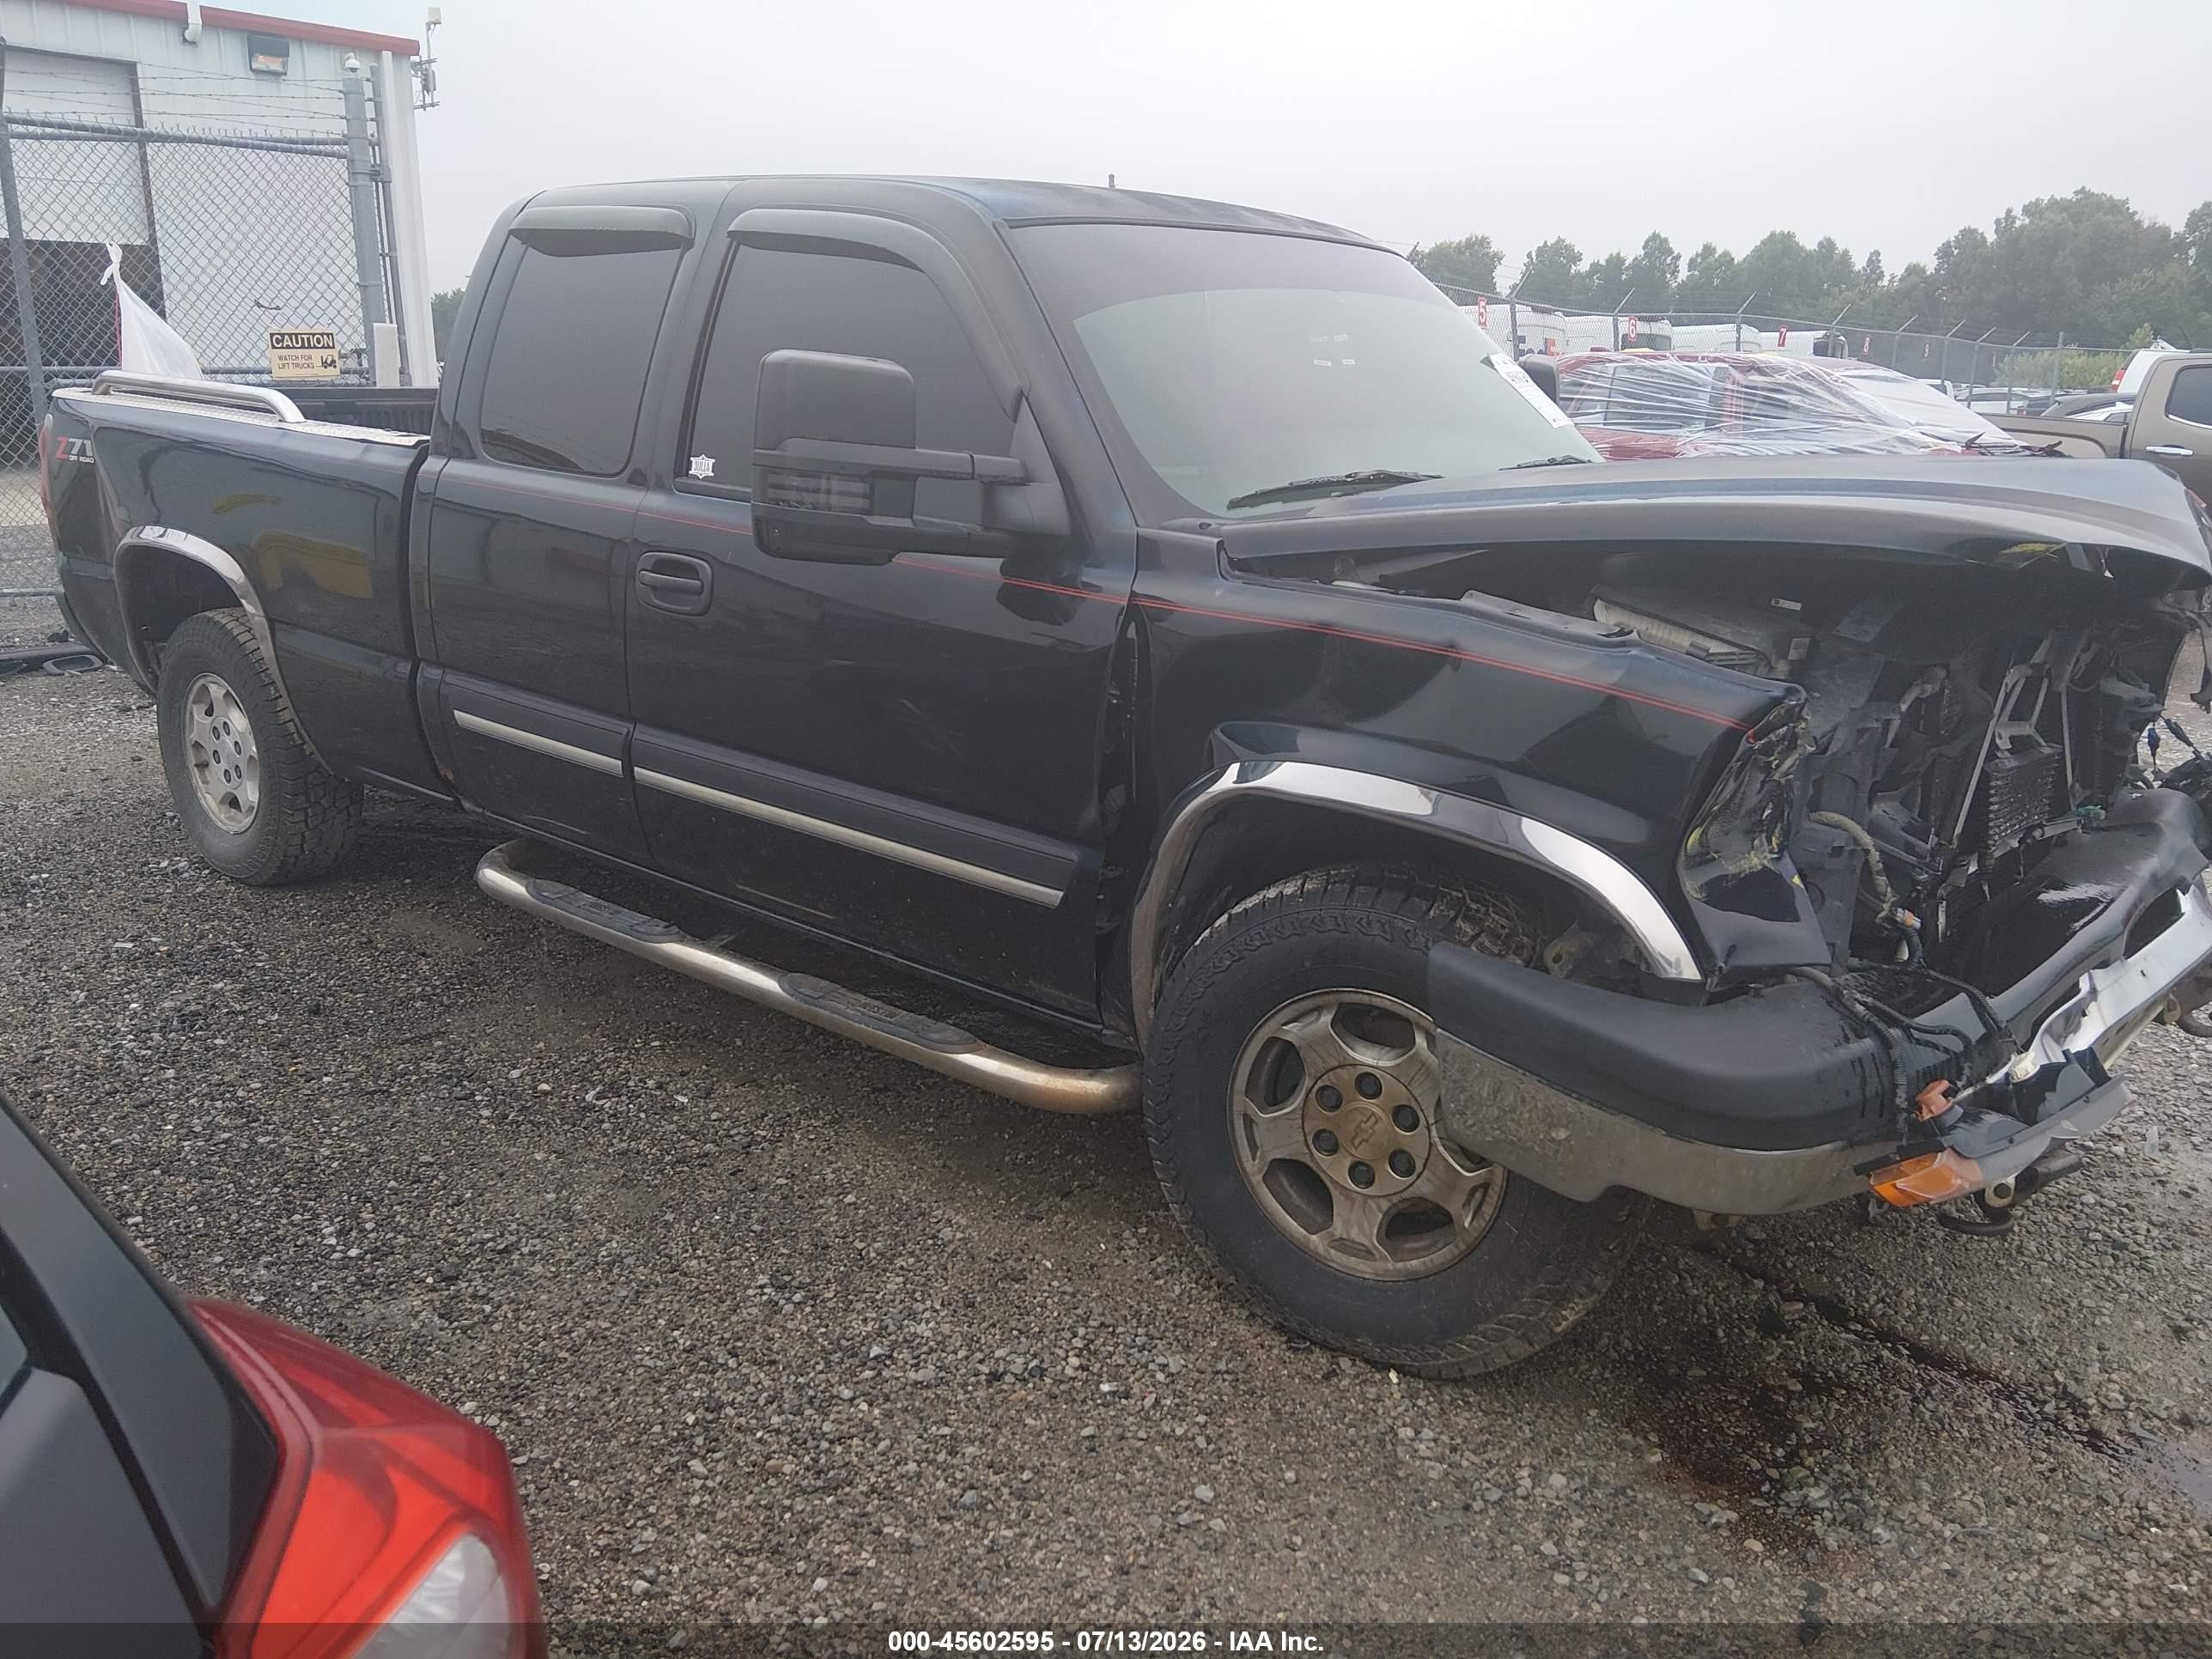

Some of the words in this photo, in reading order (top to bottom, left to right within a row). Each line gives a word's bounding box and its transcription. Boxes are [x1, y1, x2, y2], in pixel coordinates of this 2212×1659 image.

[272, 334, 333, 348] CAUTION
[1863, 337, 1870, 352] 8
[55, 436, 94, 459] Z71
